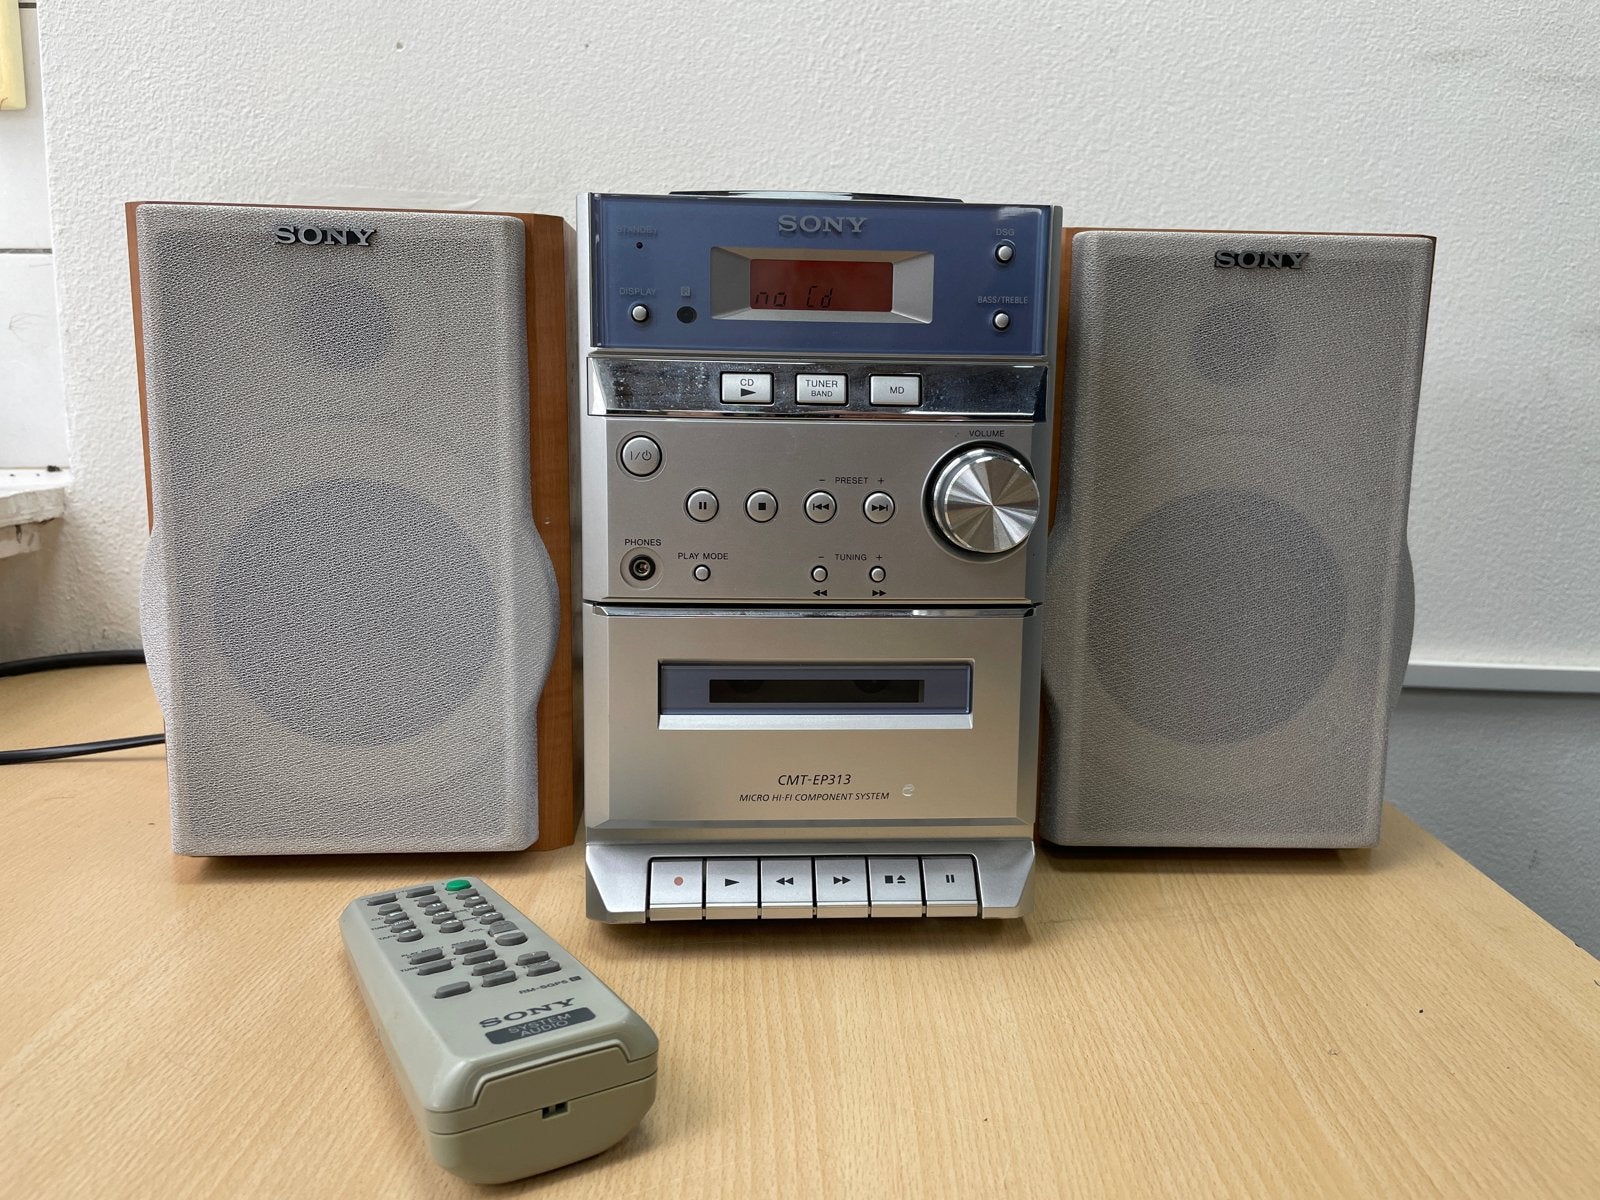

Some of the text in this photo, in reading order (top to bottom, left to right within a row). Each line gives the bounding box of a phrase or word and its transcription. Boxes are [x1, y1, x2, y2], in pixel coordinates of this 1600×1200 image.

[778, 215, 867, 234] SONY
[275, 225, 377, 246] SONY
[995, 227, 1015, 237] DSG
[1214, 250, 1310, 269] SONY
[619, 287, 656, 296] DISPLAY
[977, 295, 1028, 304] BASS/TREBLE
[739, 377, 755, 387] CD
[805, 379, 838, 388] TUNER
[811, 389, 833, 398] BAND
[889, 385, 905, 395] MD
[969, 429, 1005, 438] VOLUME
[834, 476, 869, 485] PRESET
[624, 538, 662, 547] PHONES
[677, 552, 729, 561] PLAY MODE
[834, 553, 868, 562] TUNING
[778, 774, 852, 786] CMT-EP313
[739, 792, 890, 802] MICRO HI-FI COMPONENT SYSTEM
[479, 997, 575, 1028] SONY
[508, 1013, 572, 1034] SYSTEM
[520, 1020, 569, 1037] AUDIO
